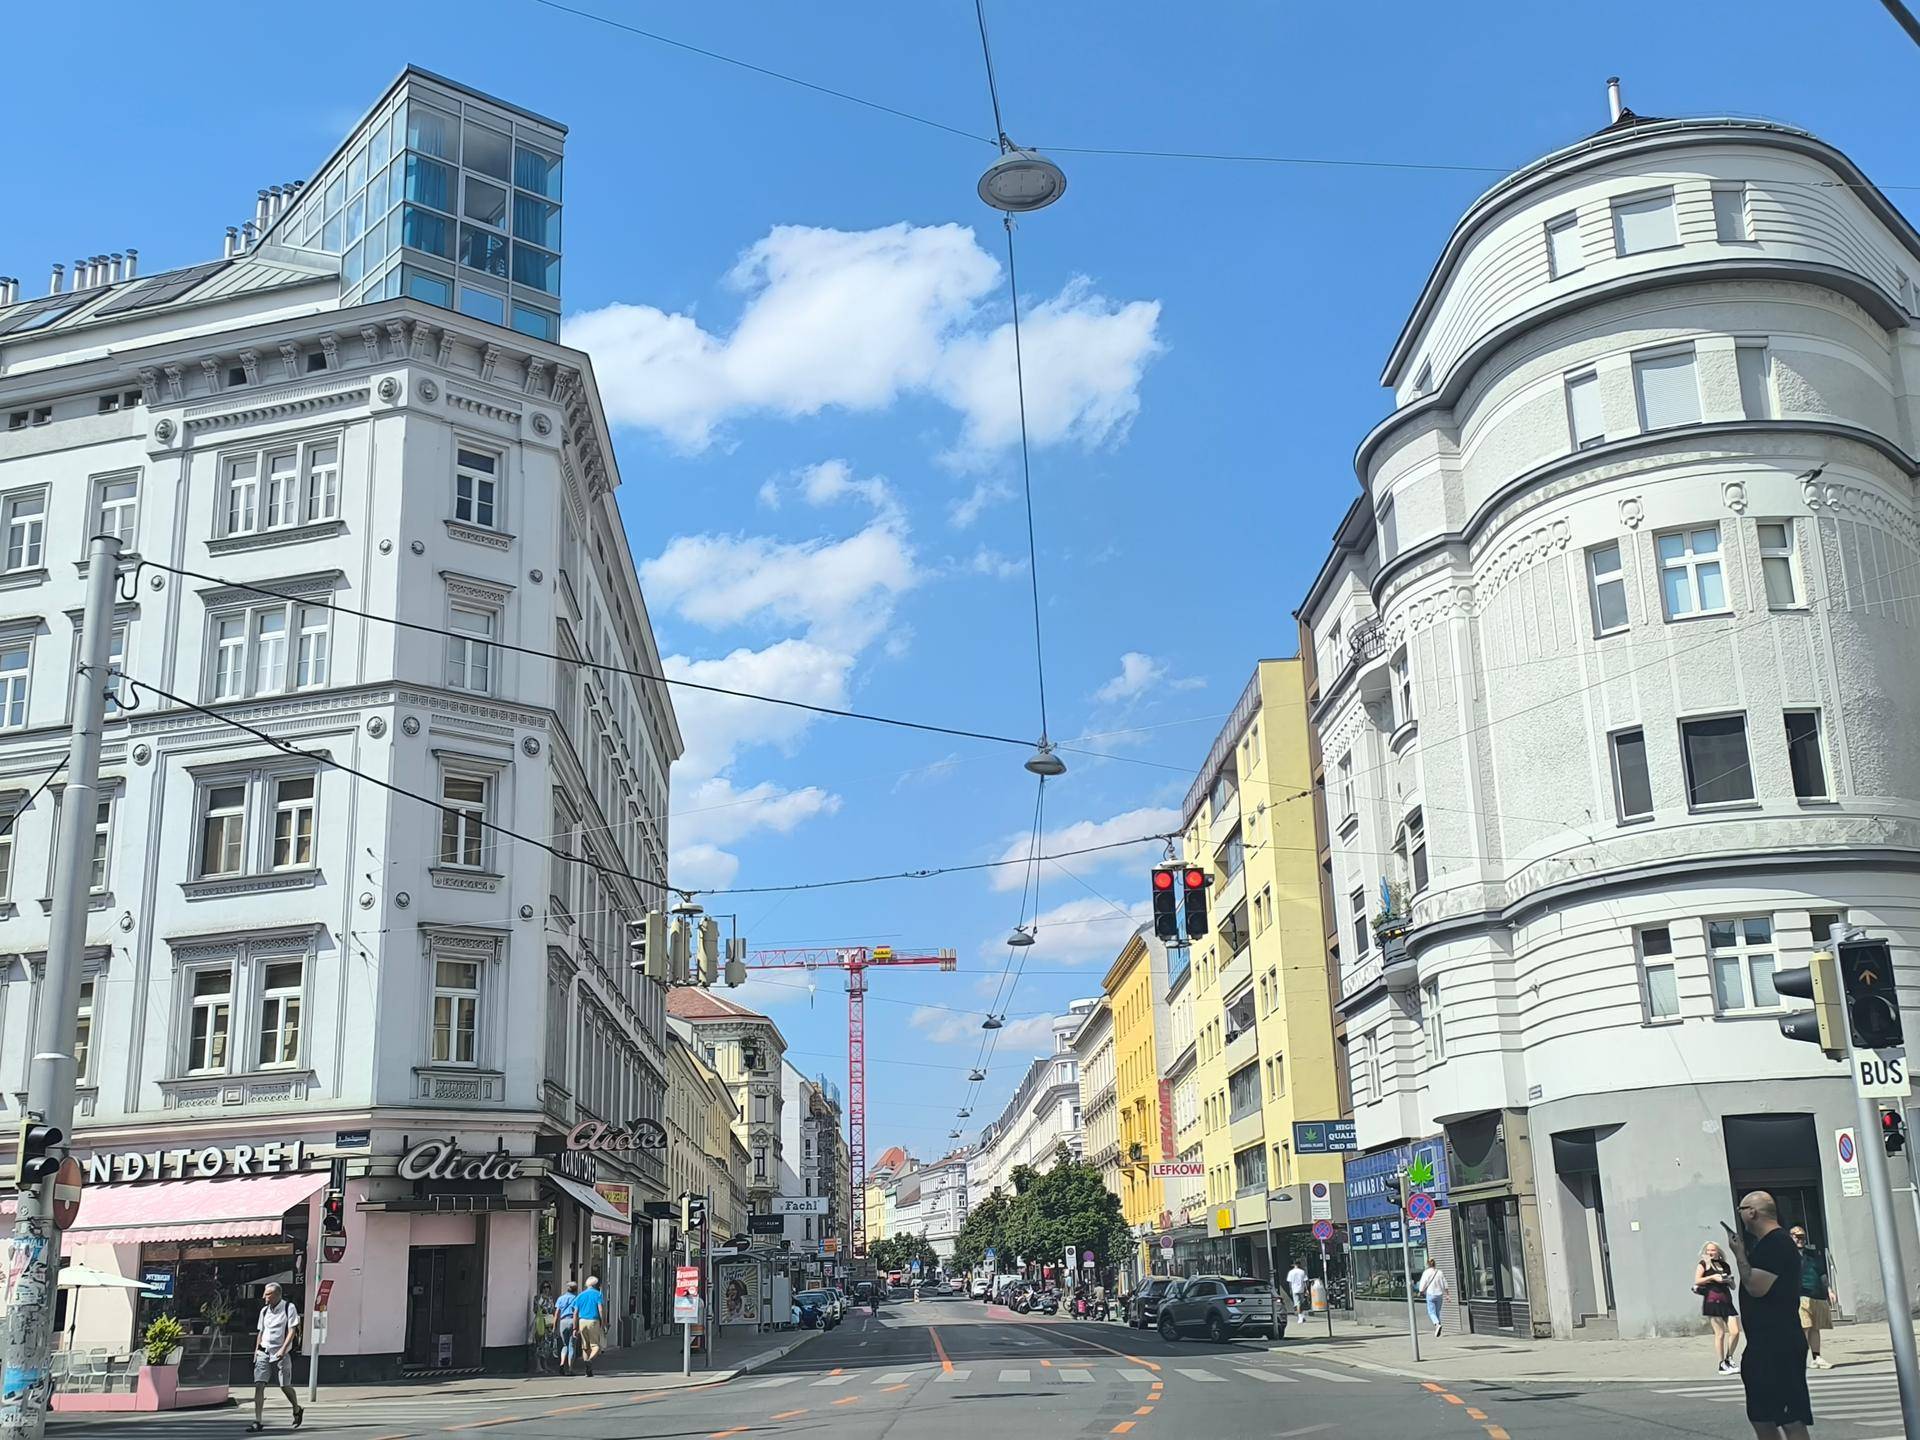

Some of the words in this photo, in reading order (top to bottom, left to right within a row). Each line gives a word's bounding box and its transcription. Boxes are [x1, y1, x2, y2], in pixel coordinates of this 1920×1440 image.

[1861, 1059, 1903, 1085] BUS
[567, 1118, 667, 1150] Aida
[89, 1140, 304, 1184] NDITOREI
[397, 1138, 525, 1180] Aida
[1350, 1176, 1386, 1198] CANNABIS
[785, 1201, 817, 1211] Fachl
